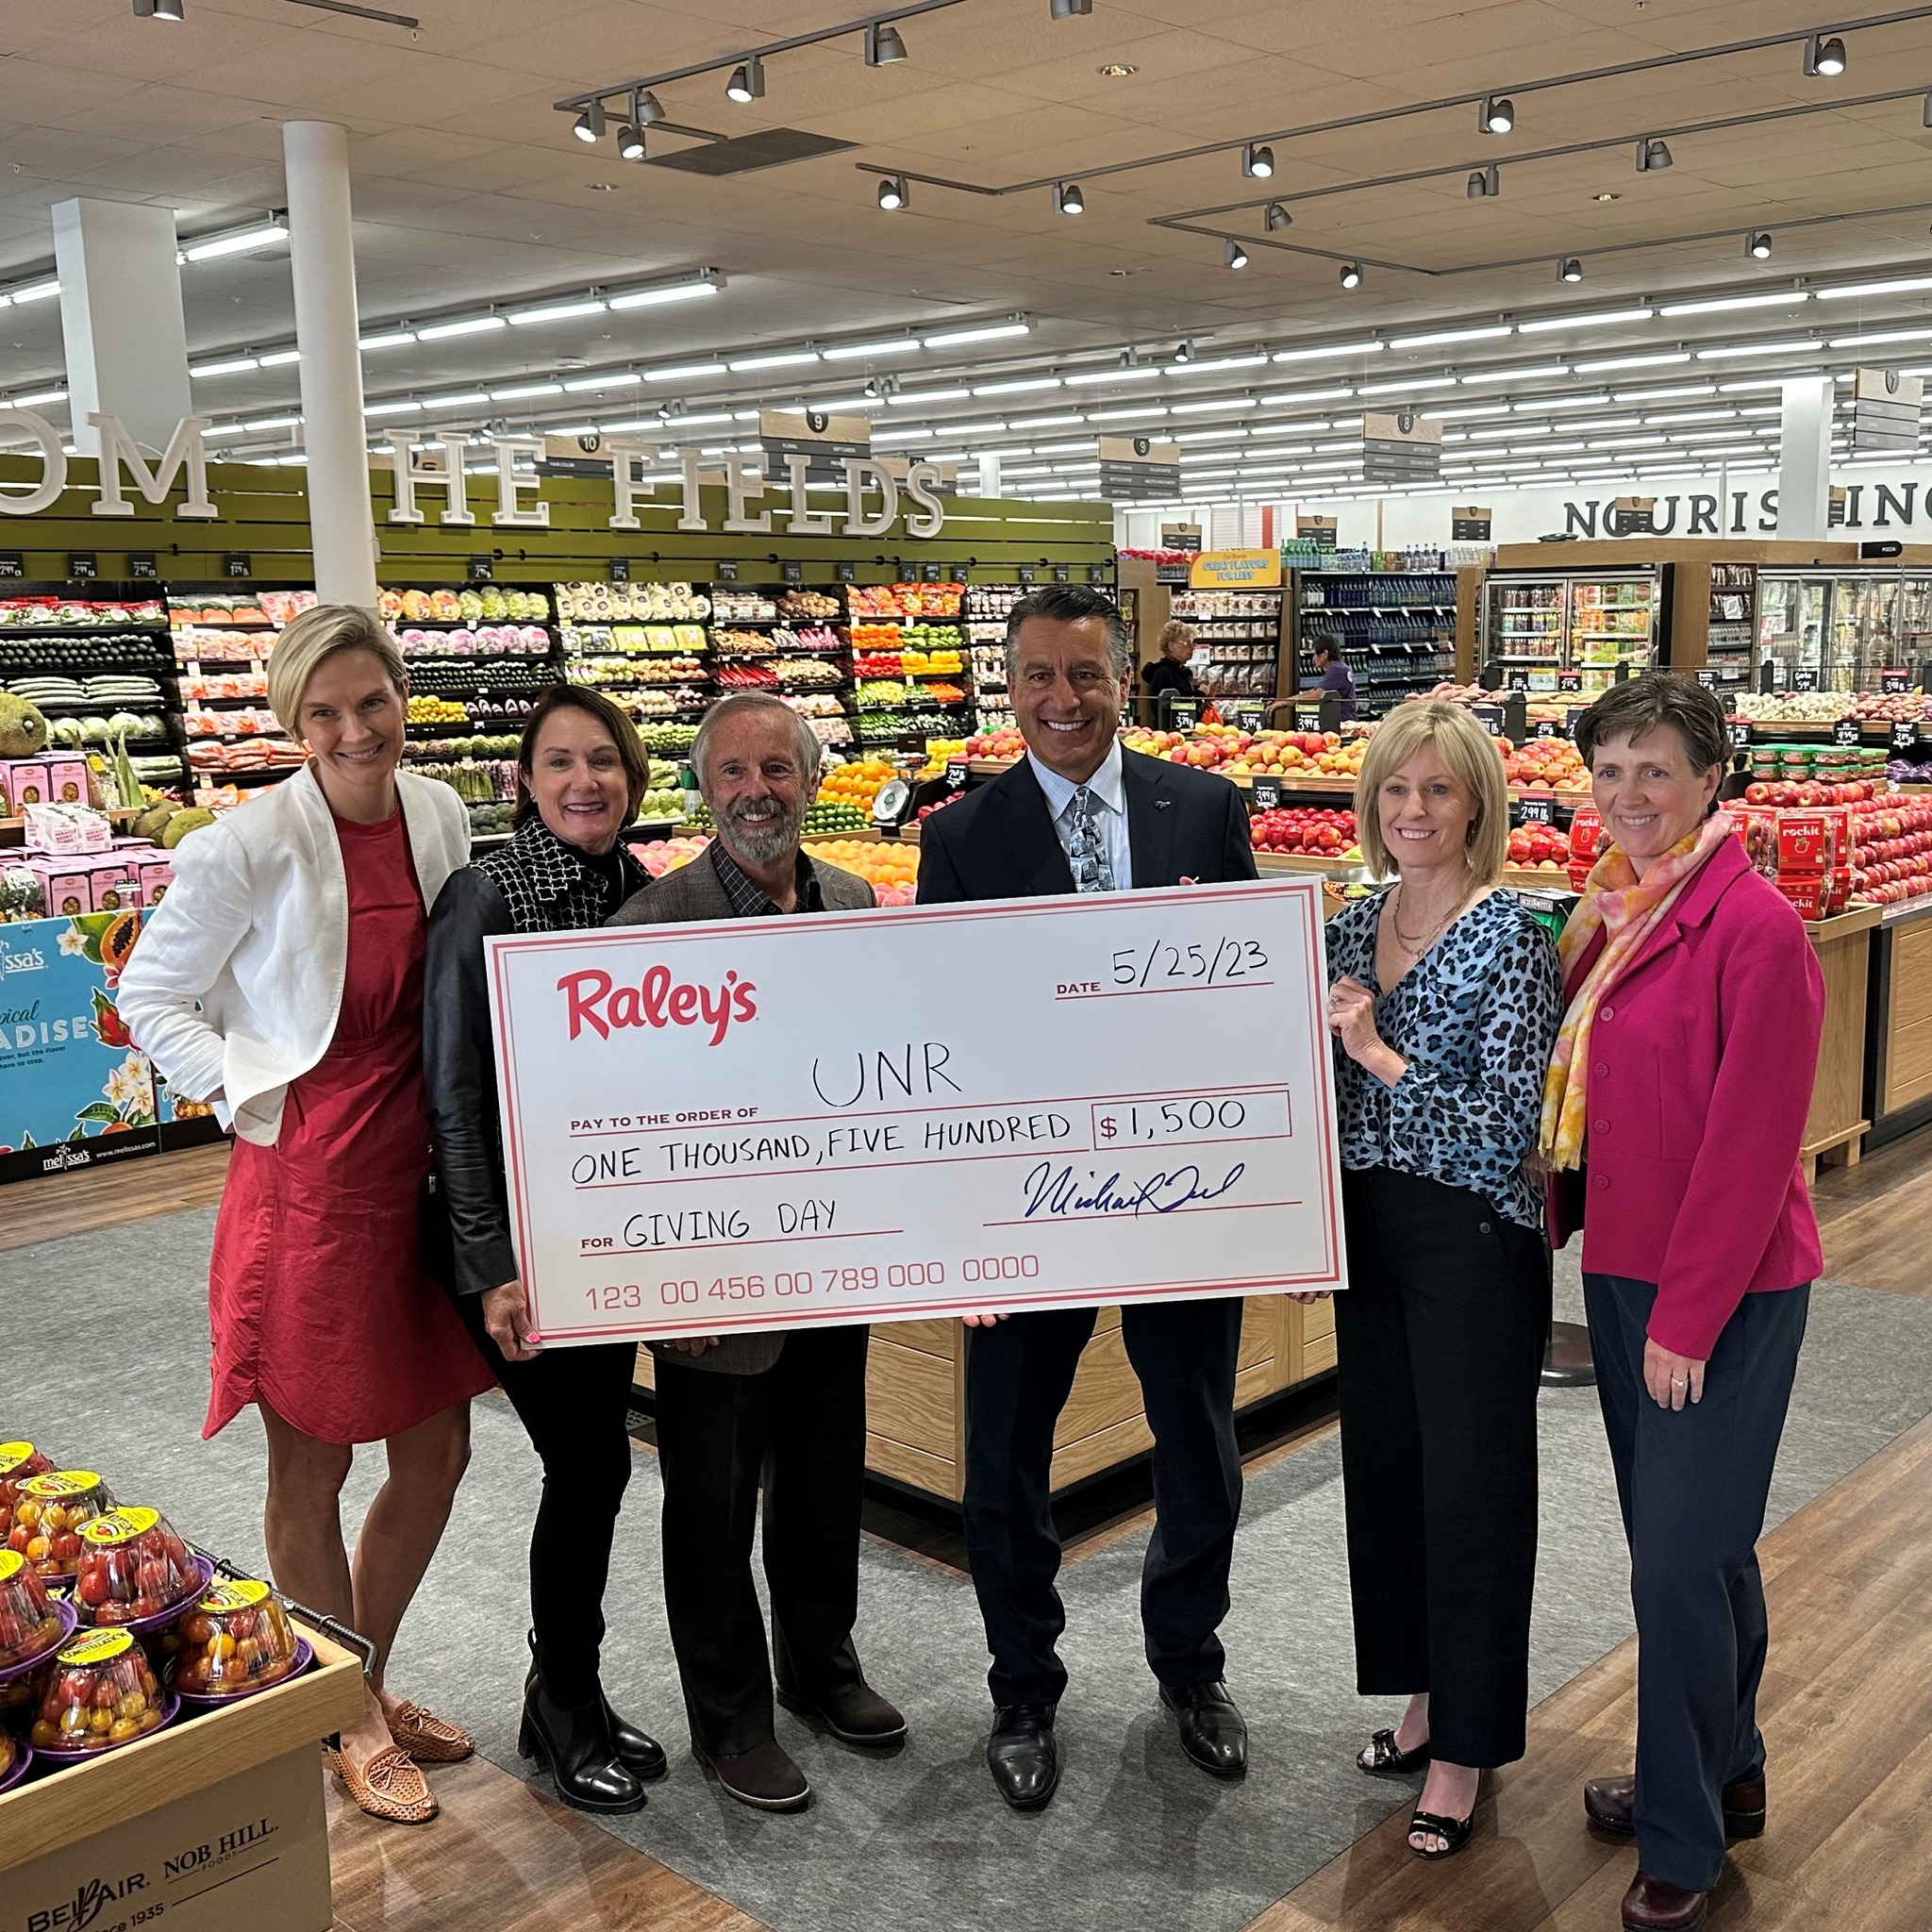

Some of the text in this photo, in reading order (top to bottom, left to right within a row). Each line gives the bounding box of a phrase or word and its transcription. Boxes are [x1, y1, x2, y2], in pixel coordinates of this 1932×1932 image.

[814, 414, 824, 429] 9
[1404, 416, 1410, 430] 8
[582, 436, 596, 451] 10
[1139, 441, 1146, 454] 9
[605, 441, 946, 539] FIELDS
[1203, 558, 1269, 571] GREAT FLAVORS
[1217, 570, 1254, 581] FOR LESS
[1256, 791, 1271, 803] 399
[1521, 806, 1539, 819] 299
[1782, 825, 1820, 837] rockit
[1830, 884, 1842, 895] kit
[1791, 898, 1813, 908] ckit
[1057, 937, 1268, 994] DATE 5/25/23
[557, 964, 758, 1047] Raley's
[17, 1050, 30, 1058] but
[31, 1048, 44, 1057] the
[571, 1042, 962, 1131] PAY TO THE ORDER OF UNR
[1100, 1099, 1246, 1141] $ 1,500
[571, 1147, 641, 1185] ONE
[924, 1113, 1072, 1151] HUNDRED
[581, 1199, 836, 1249] FOR GIVING DAY
[585, 1255, 1040, 1310] 123 00 456 00 789 000 0000
[163, 1844, 212, 1880] NOB
[200, 1851, 239, 1872] FOODS
[130, 1903, 165, 1928] 1935
